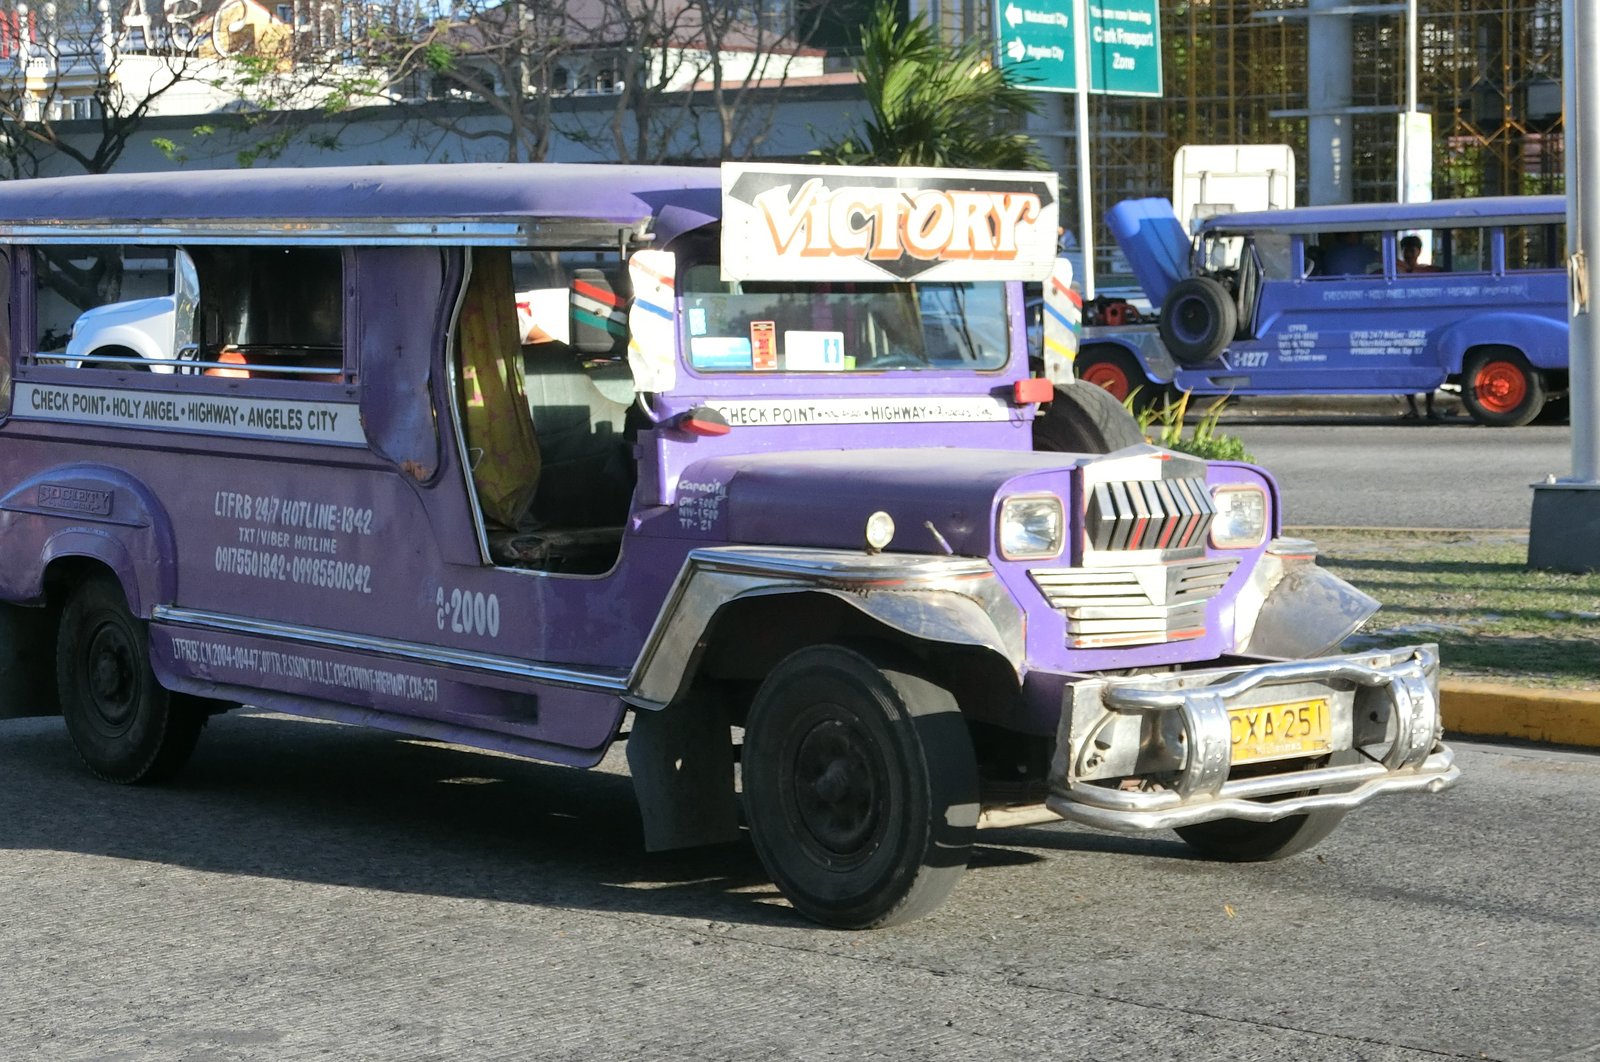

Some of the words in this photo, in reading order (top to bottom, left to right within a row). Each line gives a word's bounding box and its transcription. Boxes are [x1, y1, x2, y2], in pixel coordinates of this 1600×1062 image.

[1112, 52, 1135, 70] Zone
[754, 177, 1041, 261] VICTORY
[31, 388, 70, 411] CHECK
[72, 392, 106, 415] POINT
[112, 396, 141, 419] HOLY
[142, 398, 180, 421] ANGEL
[187, 402, 240, 427] HIGHWAY
[247, 407, 303, 431] ANGELES
[307, 410, 339, 433] CITY
[718, 406, 767, 424] CHECK
[773, 406, 816, 423] POINT
[870, 405, 927, 421] HIGHWAY
[214, 491, 252, 521] LTFRB
[255, 495, 279, 525] 24/7
[294, 534, 337, 555] HOTLINE
[215, 545, 286, 581] 09175501342
[292, 555, 373, 594] 09985501342
[1230, 711, 1273, 745] CXA
[1283, 704, 1322, 738] 251
